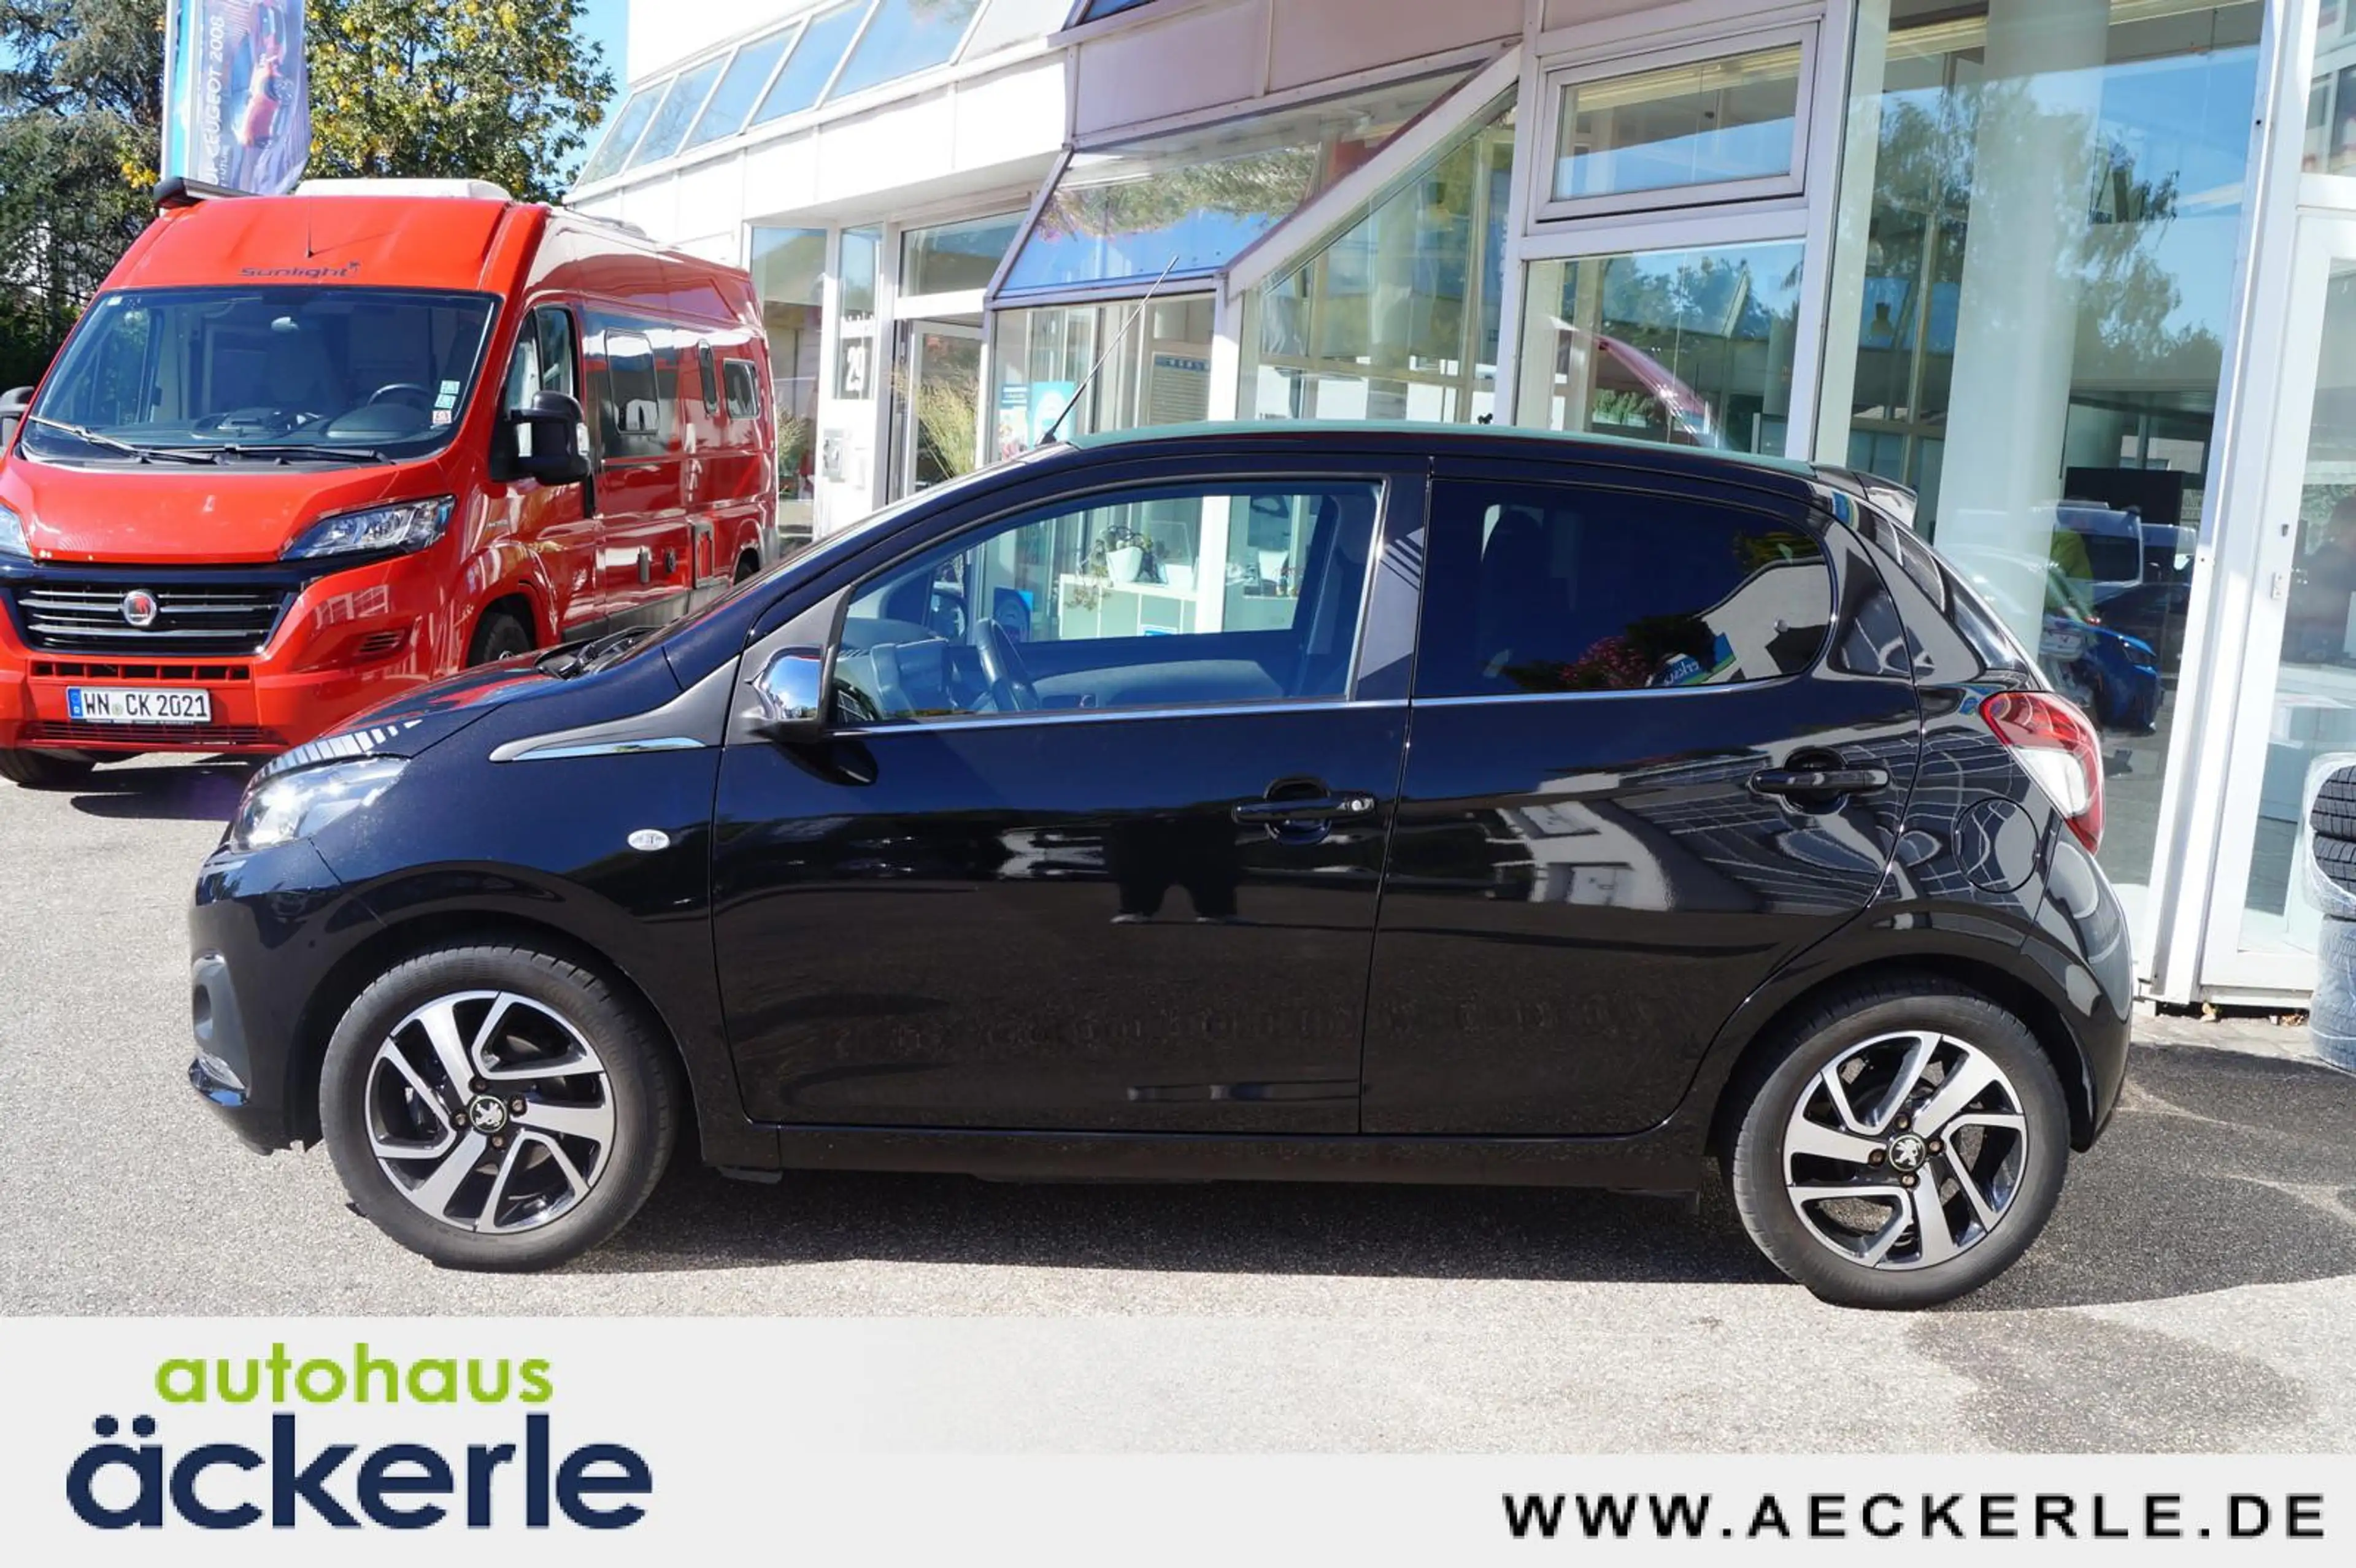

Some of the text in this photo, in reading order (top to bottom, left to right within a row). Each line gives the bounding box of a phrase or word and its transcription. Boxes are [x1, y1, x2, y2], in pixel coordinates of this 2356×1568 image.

[210, 15, 225, 63] 2008
[241, 267, 348, 278] Sunlight
[83, 693, 207, 717] WN CK 2021
